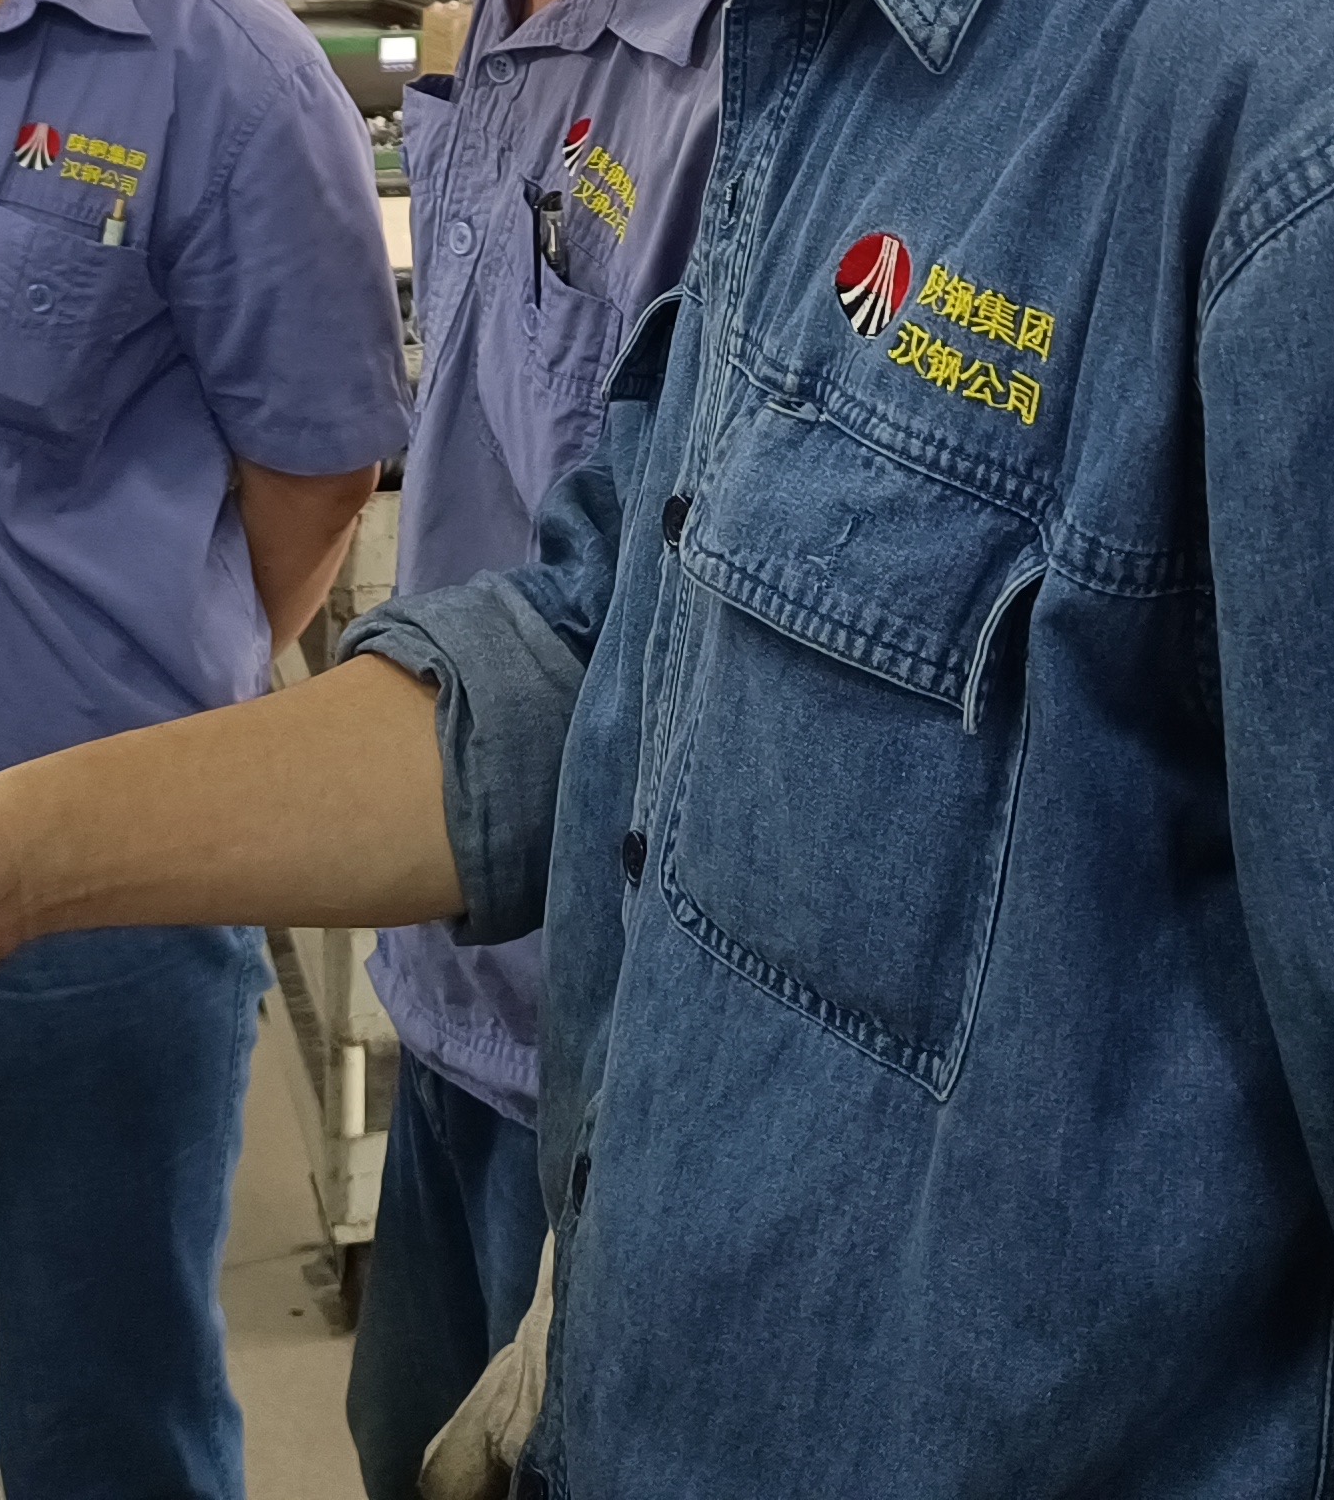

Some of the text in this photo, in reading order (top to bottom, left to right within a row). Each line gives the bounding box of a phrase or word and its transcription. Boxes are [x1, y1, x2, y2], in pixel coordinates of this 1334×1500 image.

[60, 157, 138, 197] 汉钢公司
[66, 133, 147, 171] 陕钢集团
[916, 263, 1056, 363] 陕钢集团
[887, 320, 1041, 426] 汉钢公司
